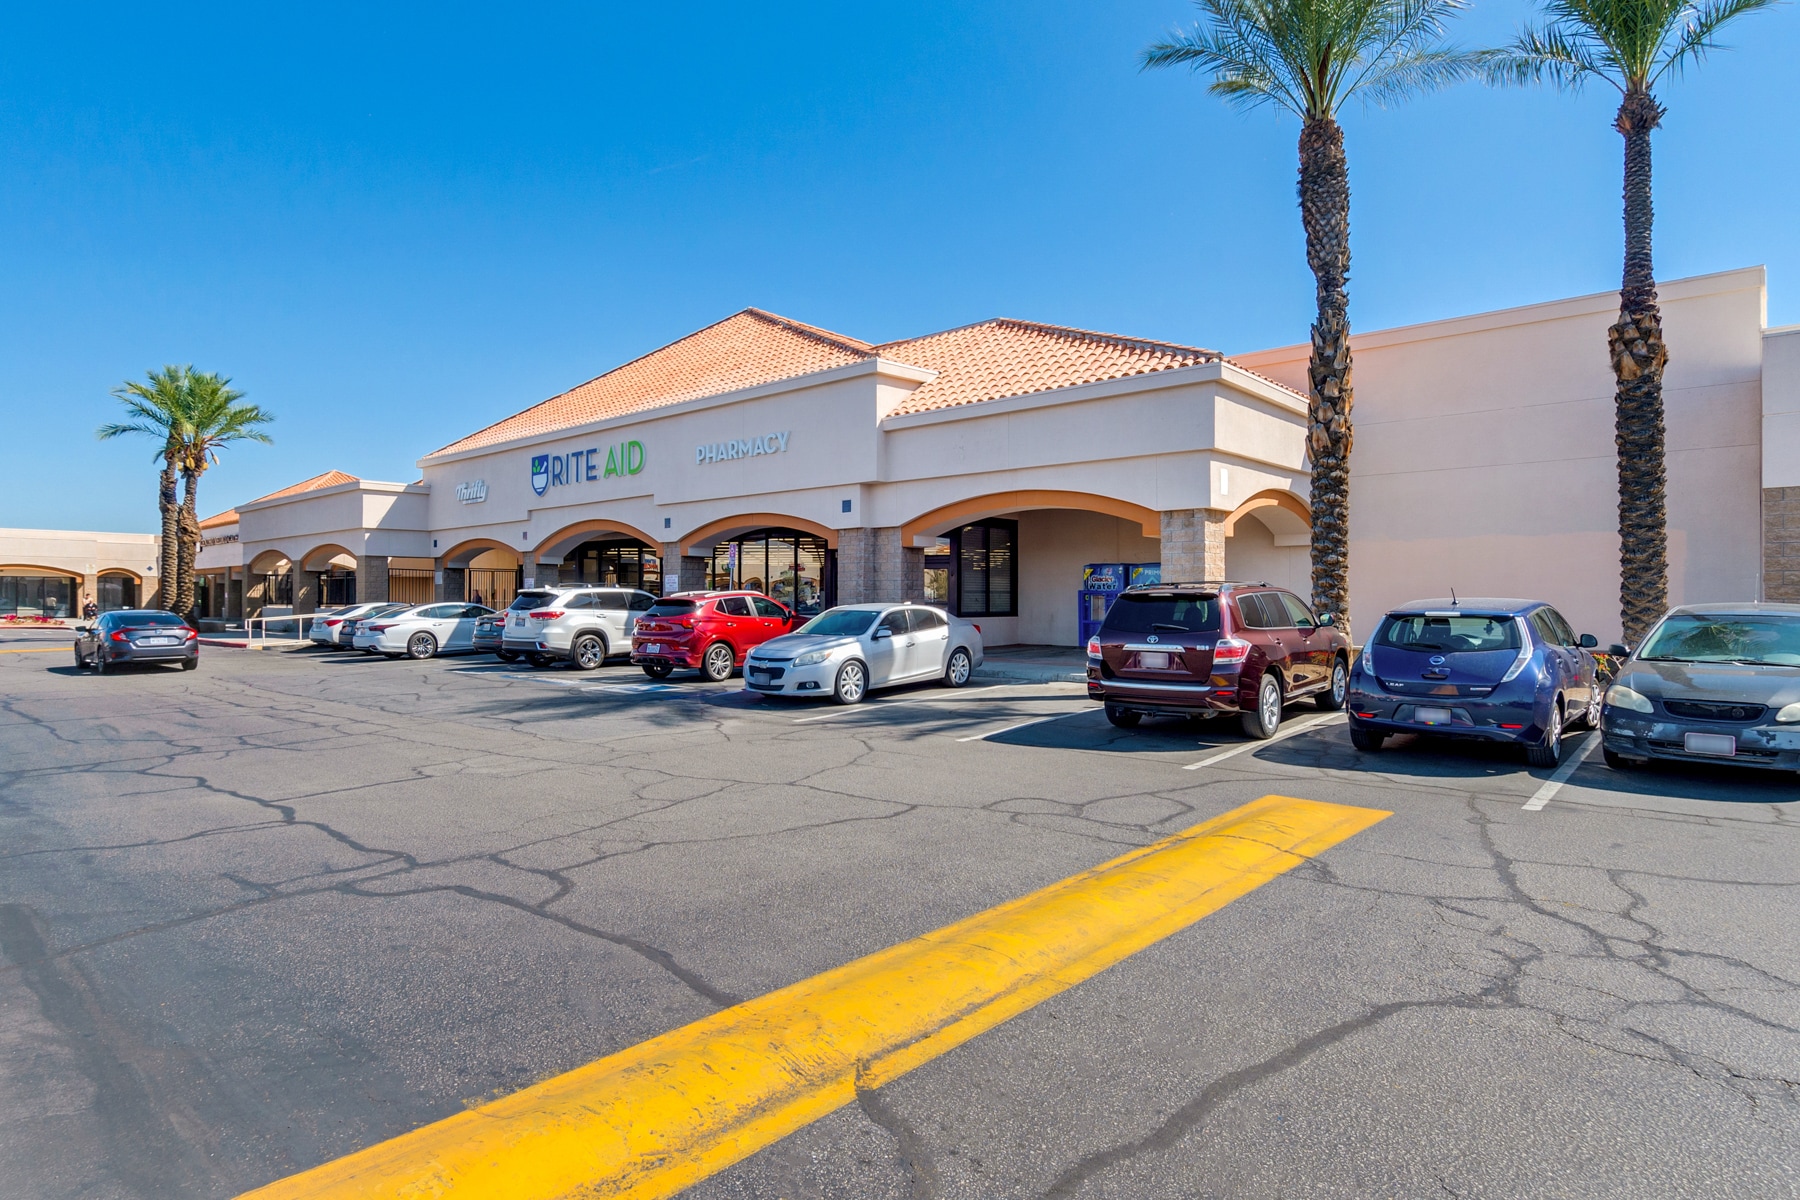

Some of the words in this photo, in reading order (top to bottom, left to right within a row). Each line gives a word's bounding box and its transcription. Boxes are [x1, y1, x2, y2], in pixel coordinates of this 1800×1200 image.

[696, 431, 790, 465] PHARMACY
[552, 447, 600, 487] RITE
[603, 440, 647, 479] AID
[455, 479, 488, 501] Thrifty
[1088, 582, 1117, 591] Water
